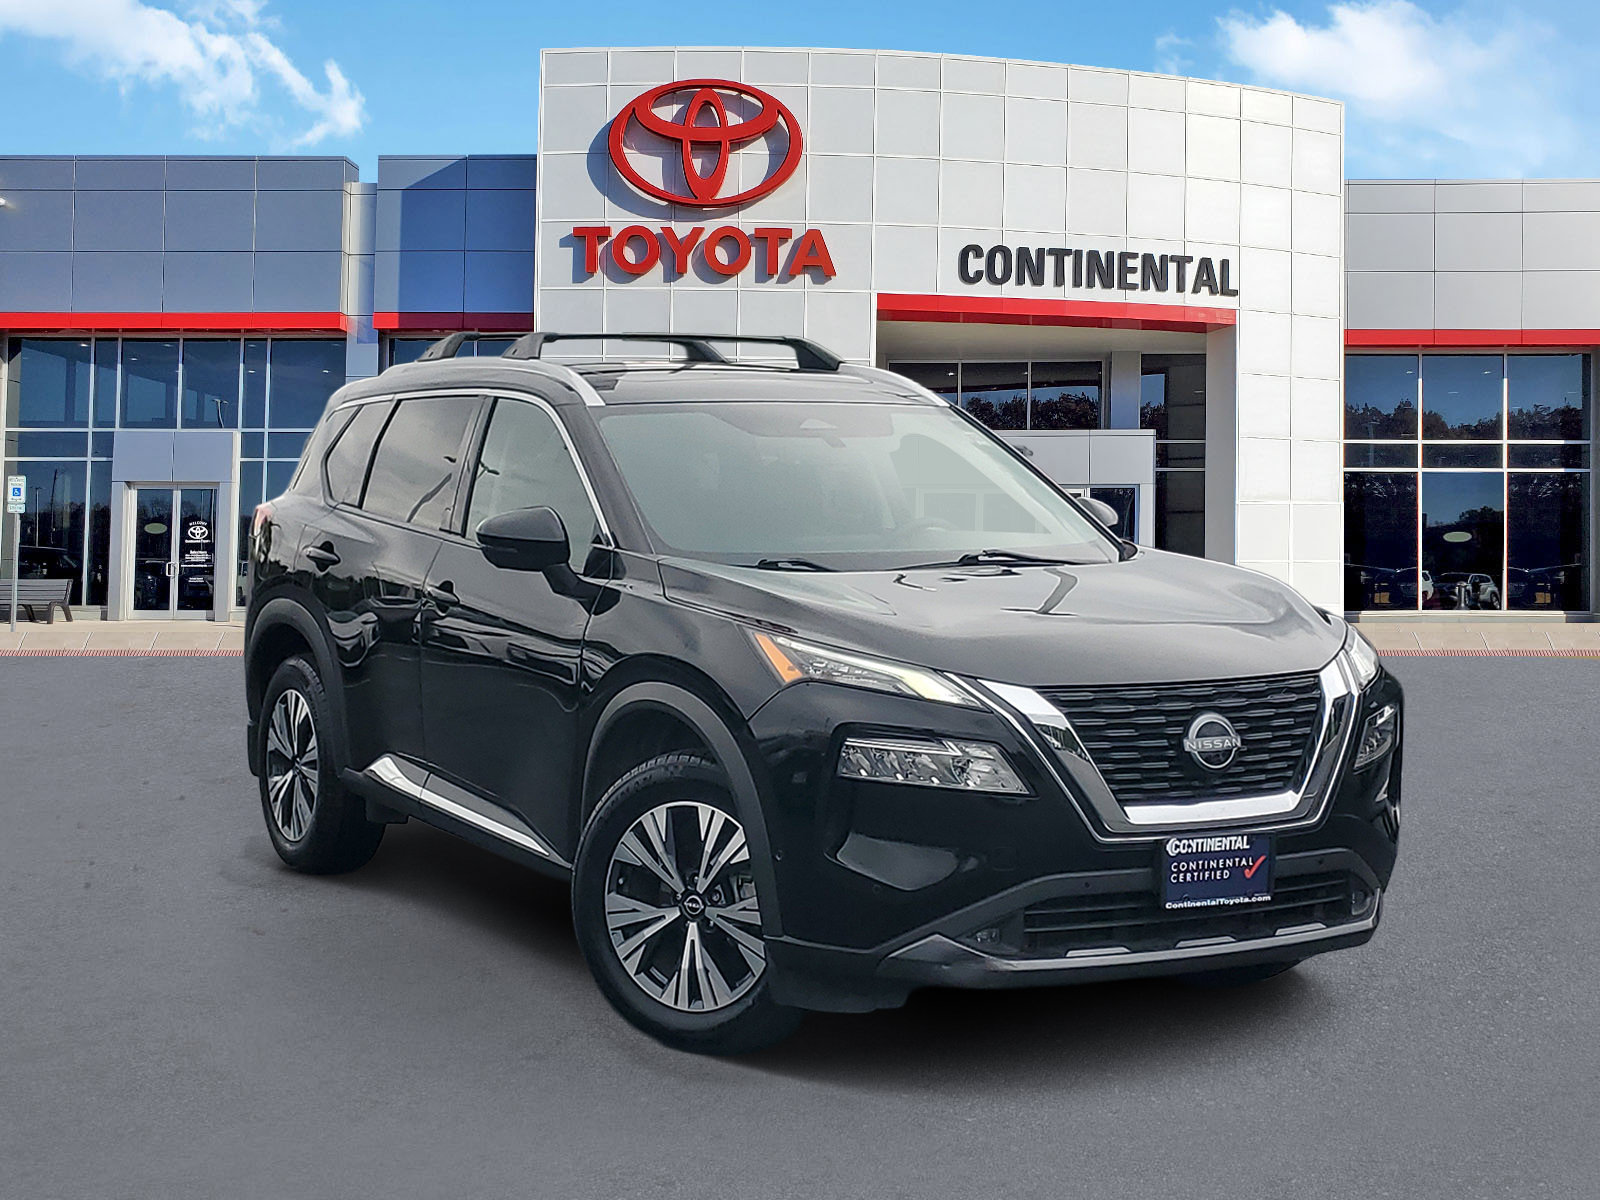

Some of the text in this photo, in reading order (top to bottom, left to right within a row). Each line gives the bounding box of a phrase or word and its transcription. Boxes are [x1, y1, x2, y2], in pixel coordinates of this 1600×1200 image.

[572, 225, 836, 277] TOYOTA
[959, 244, 1239, 296] CONTINENTAL
[1186, 738, 1241, 750] NISSAN
[1166, 836, 1250, 856] CONTINENTAL
[1171, 857, 1254, 872] CONTINENTAL
[1171, 870, 1230, 883] CERTIFIED
[1165, 895, 1271, 909] ContinentalToyota.com
